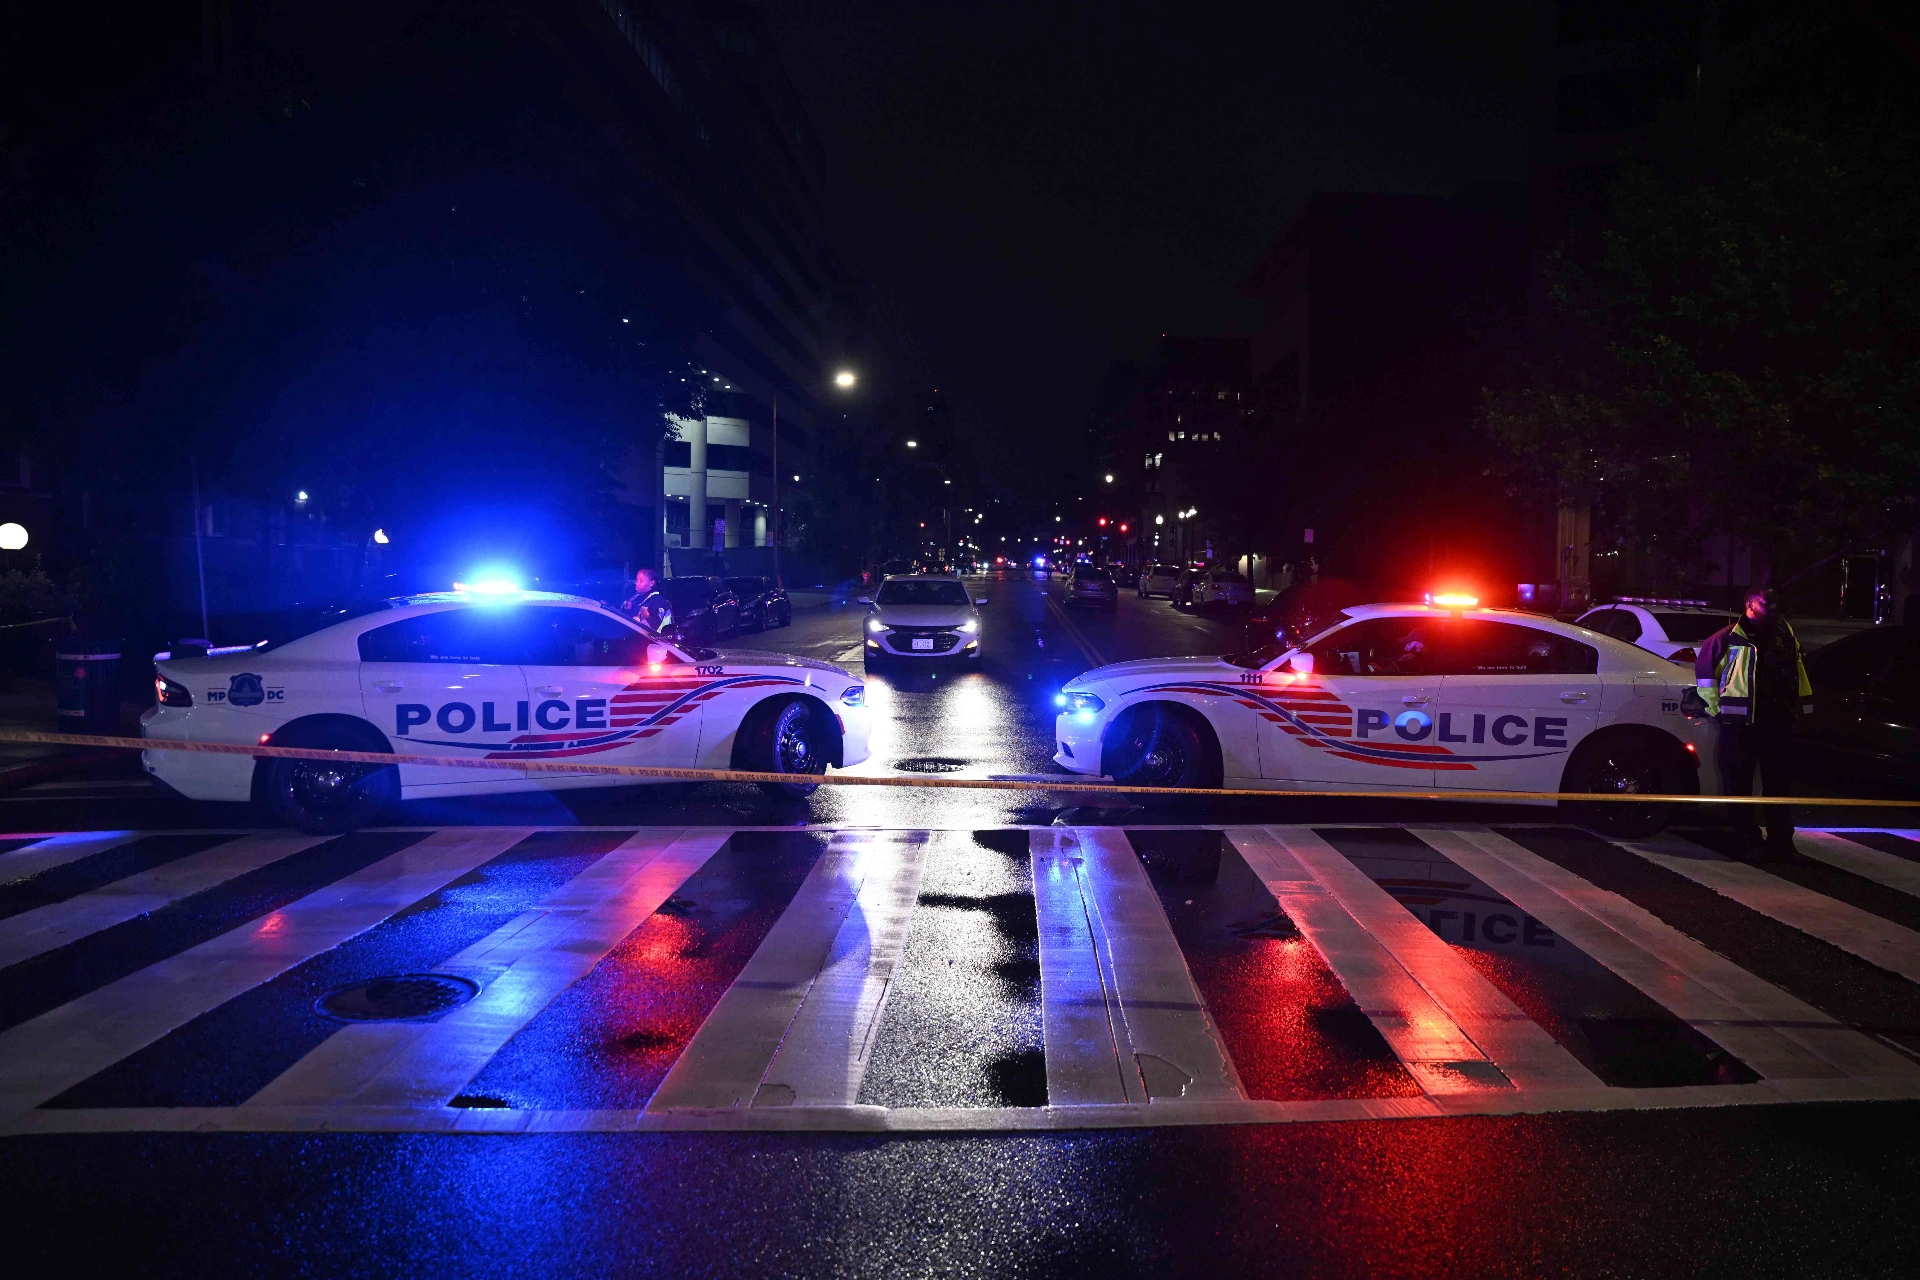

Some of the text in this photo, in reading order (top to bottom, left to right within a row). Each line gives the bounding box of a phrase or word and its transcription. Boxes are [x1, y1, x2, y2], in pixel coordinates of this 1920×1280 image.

[695, 666, 723, 675] 1702
[1240, 674, 1262, 683] 1111
[207, 691, 284, 701] MP DC
[1662, 703, 1678, 711] MP
[396, 699, 606, 735] POLICE
[1357, 708, 1567, 748] POLICE
